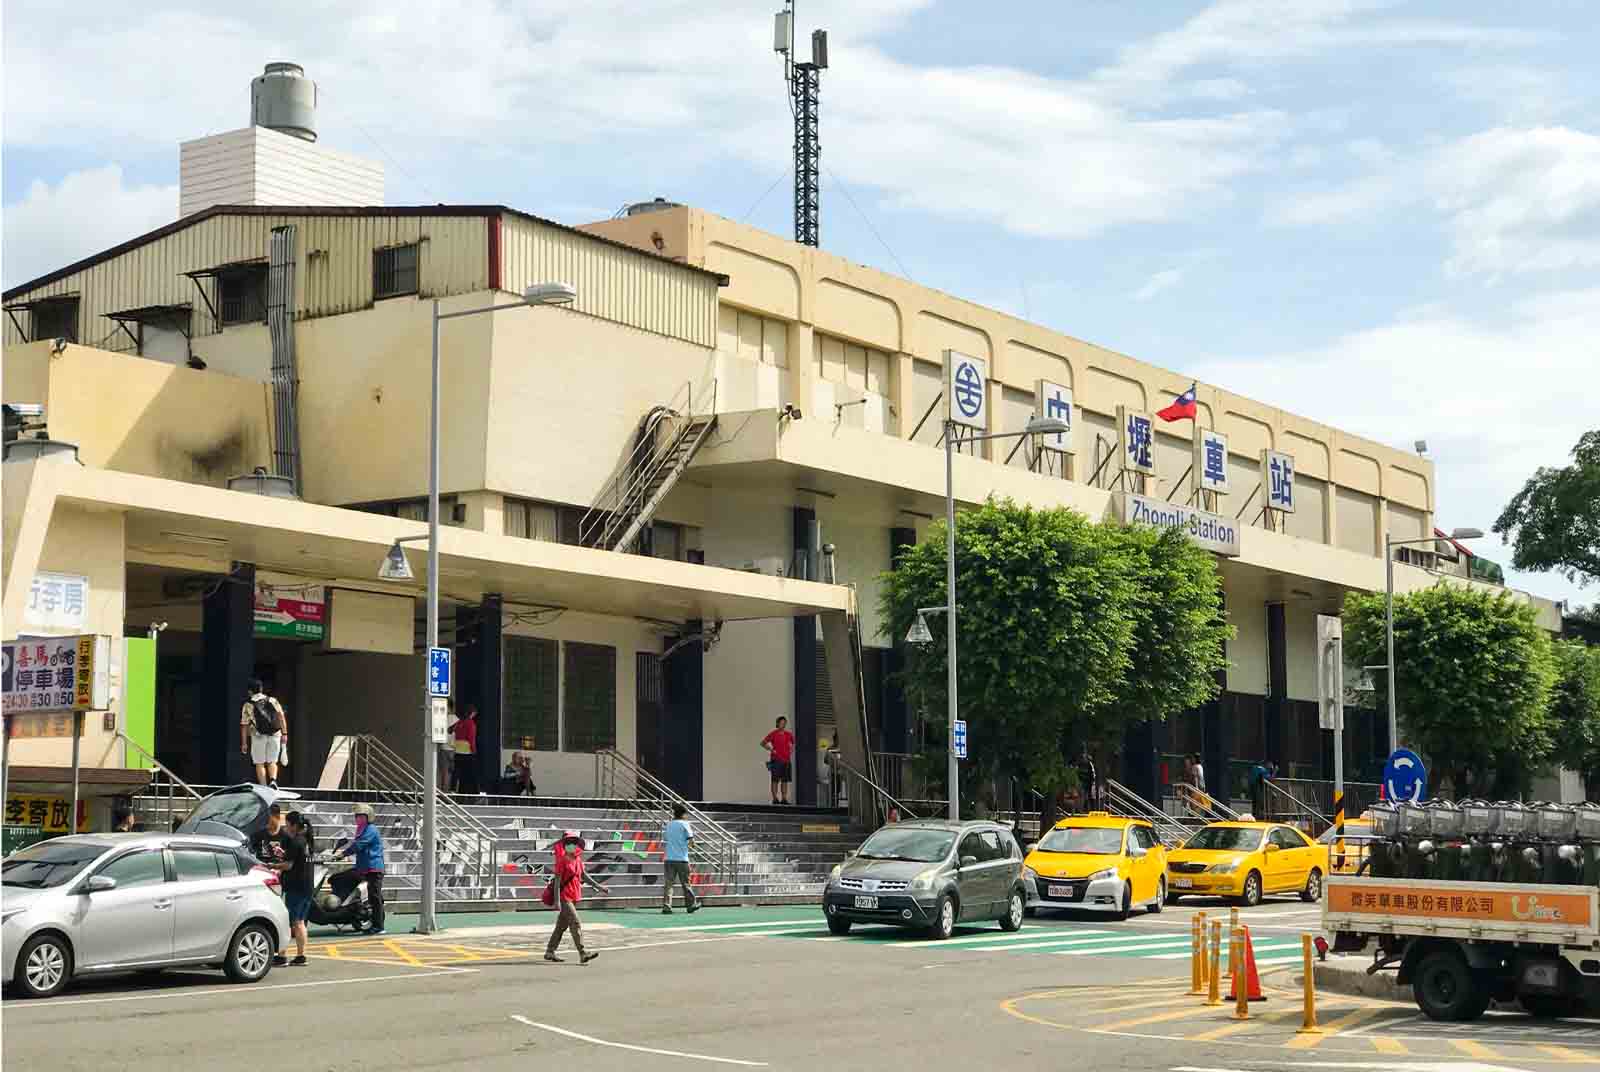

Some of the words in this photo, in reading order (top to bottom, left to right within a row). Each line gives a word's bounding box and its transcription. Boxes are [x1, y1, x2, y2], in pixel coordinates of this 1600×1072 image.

[1047, 390, 1292, 507] 中壢車站
[1132, 499, 1184, 530] Zhongli
[1189, 515, 1234, 545] Station
[16, 667, 74, 692] 停車場
[38, 692, 51, 707] 30
[61, 691, 74, 705] 50
